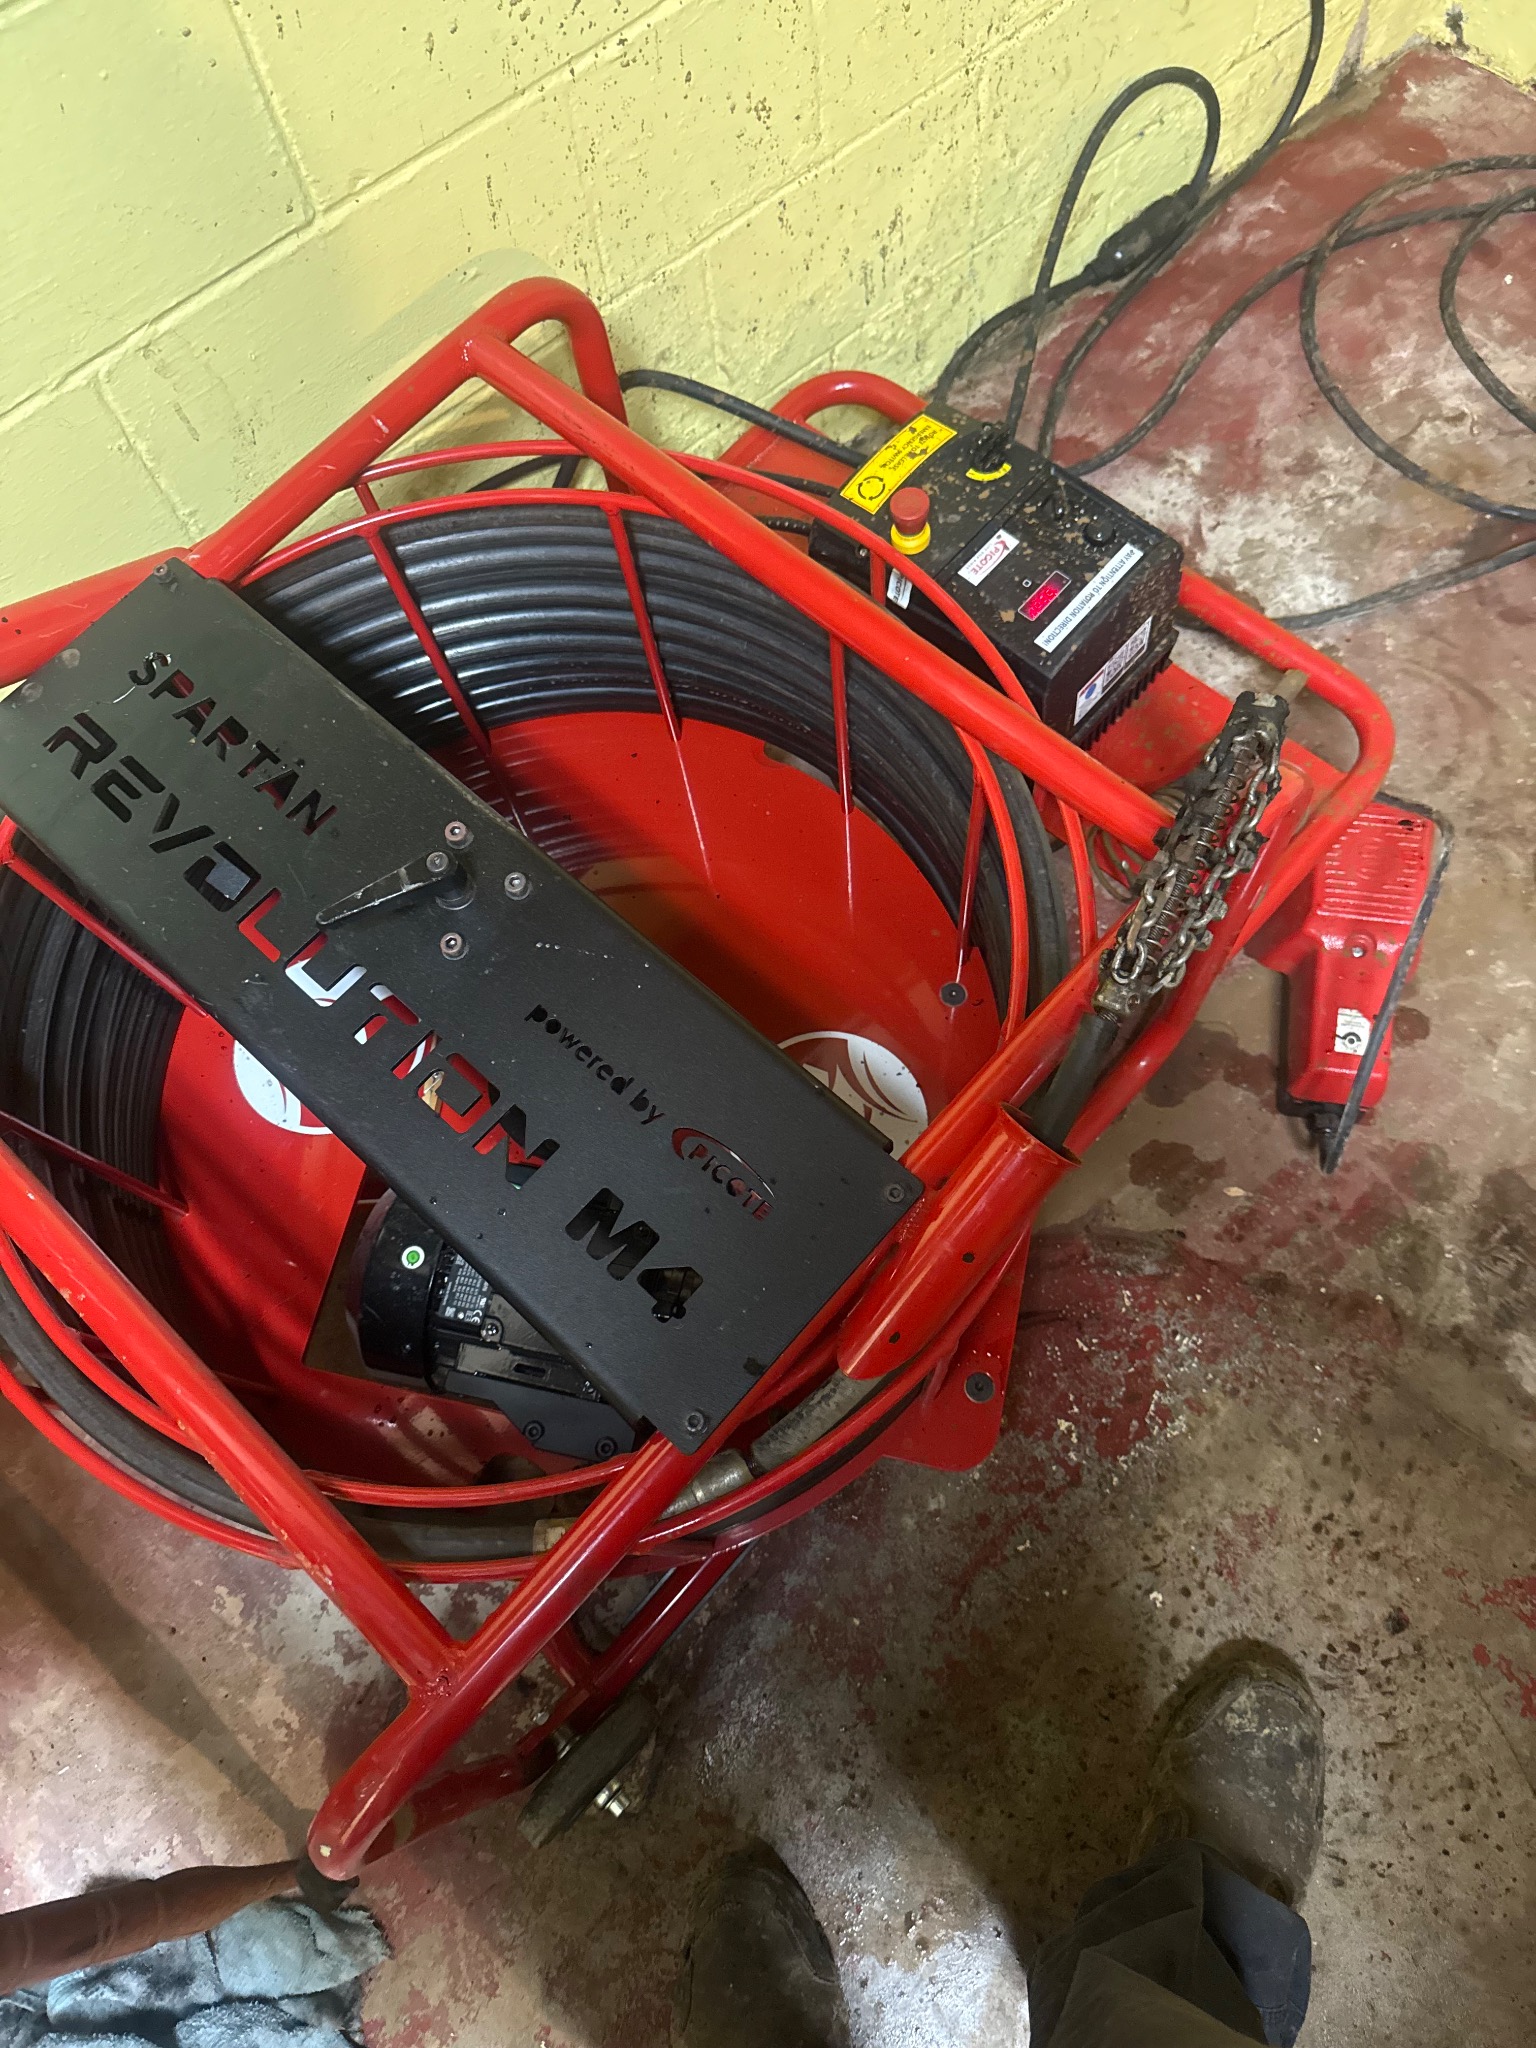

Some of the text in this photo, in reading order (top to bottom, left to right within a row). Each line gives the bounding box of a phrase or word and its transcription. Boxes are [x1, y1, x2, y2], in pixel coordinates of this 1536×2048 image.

[900, 423, 931, 450] EMERGENCY
[969, 545, 1000, 576] PICOTE
[1122, 548, 1136, 561] PAY
[1097, 557, 1126, 587] ATTENTION
[1091, 583, 1103, 594] TO
[1068, 590, 1095, 618] ROTATION
[128, 650, 338, 837] SPARTAN
[42, 711, 704, 1323] REVOLUTION M4
[524, 1003, 775, 1221] powered by PICOTE
